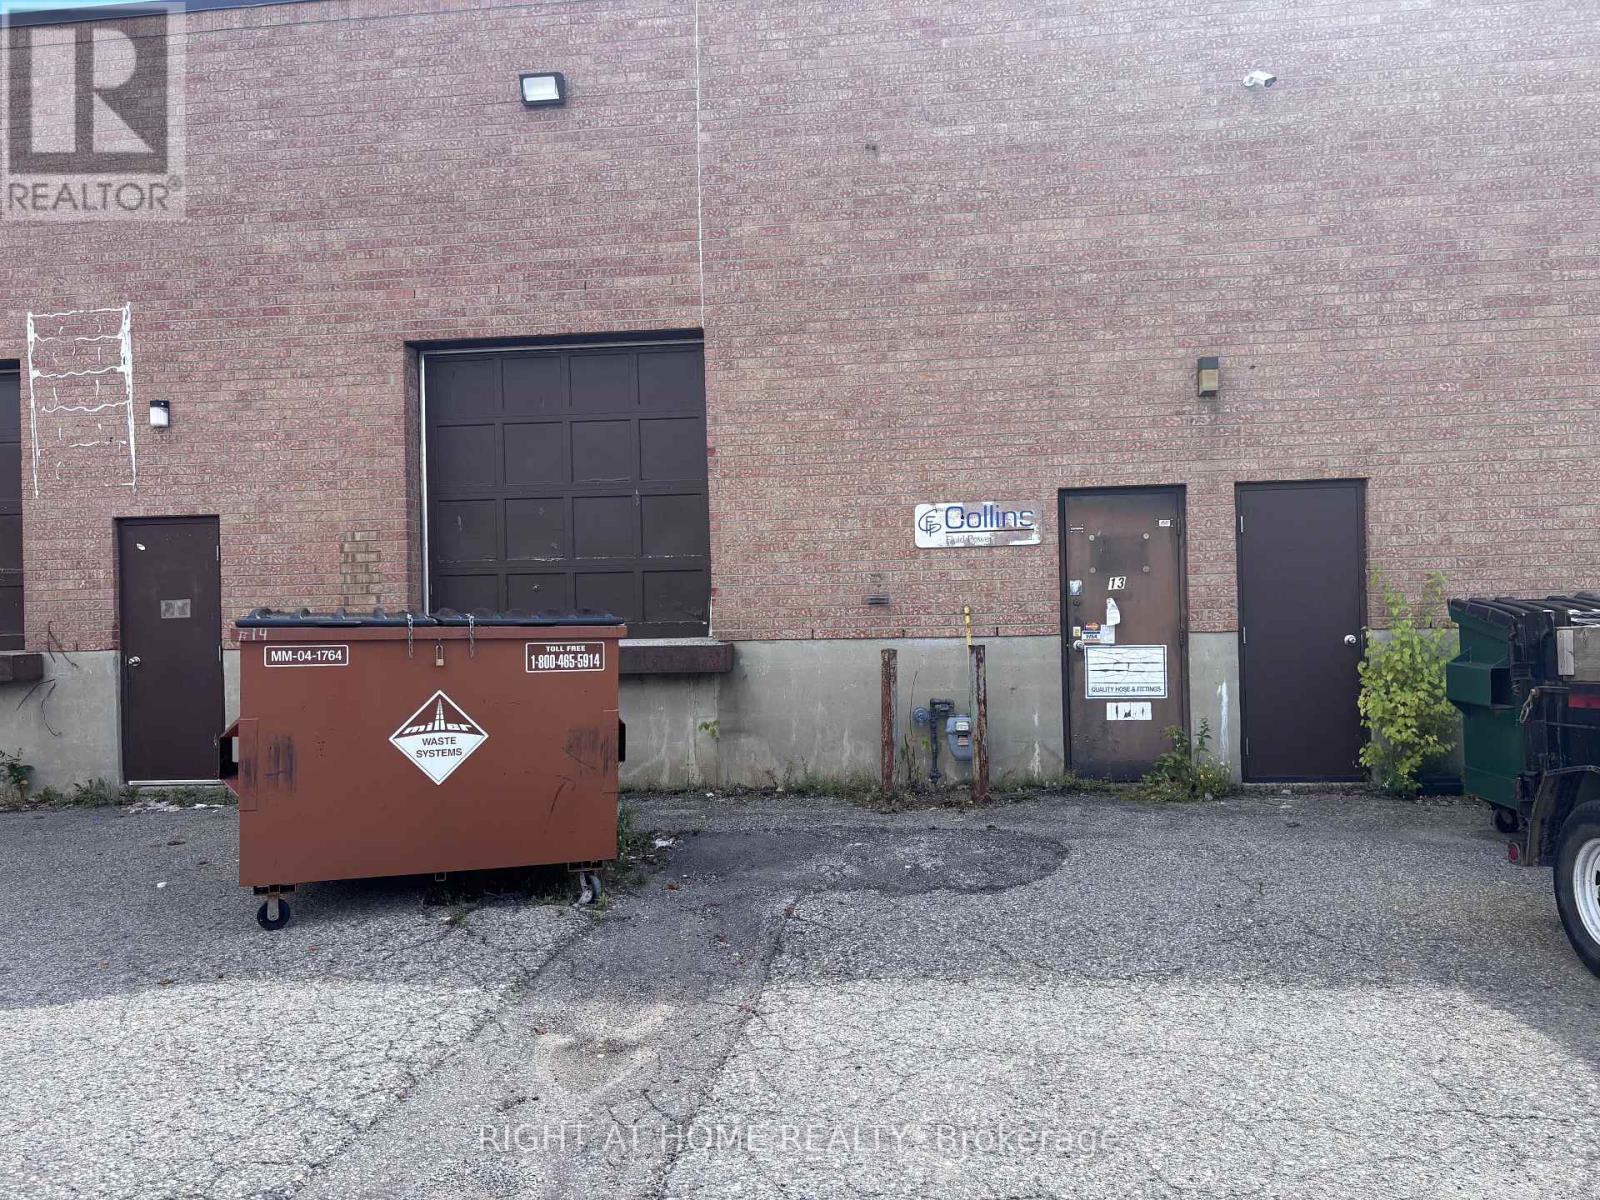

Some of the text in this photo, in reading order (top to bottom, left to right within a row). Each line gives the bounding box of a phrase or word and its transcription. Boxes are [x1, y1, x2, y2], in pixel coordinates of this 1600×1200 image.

[945, 504, 1034, 529] Collins
[1110, 577, 1125, 589] 13
[271, 650, 342, 662] MM-04-1764
[531, 653, 600, 669] 1-800-465-5914
[1137, 685, 1162, 693] FITTINGS
[422, 736, 457, 746] WASTE
[416, 748, 463, 759] SYSTEMS
